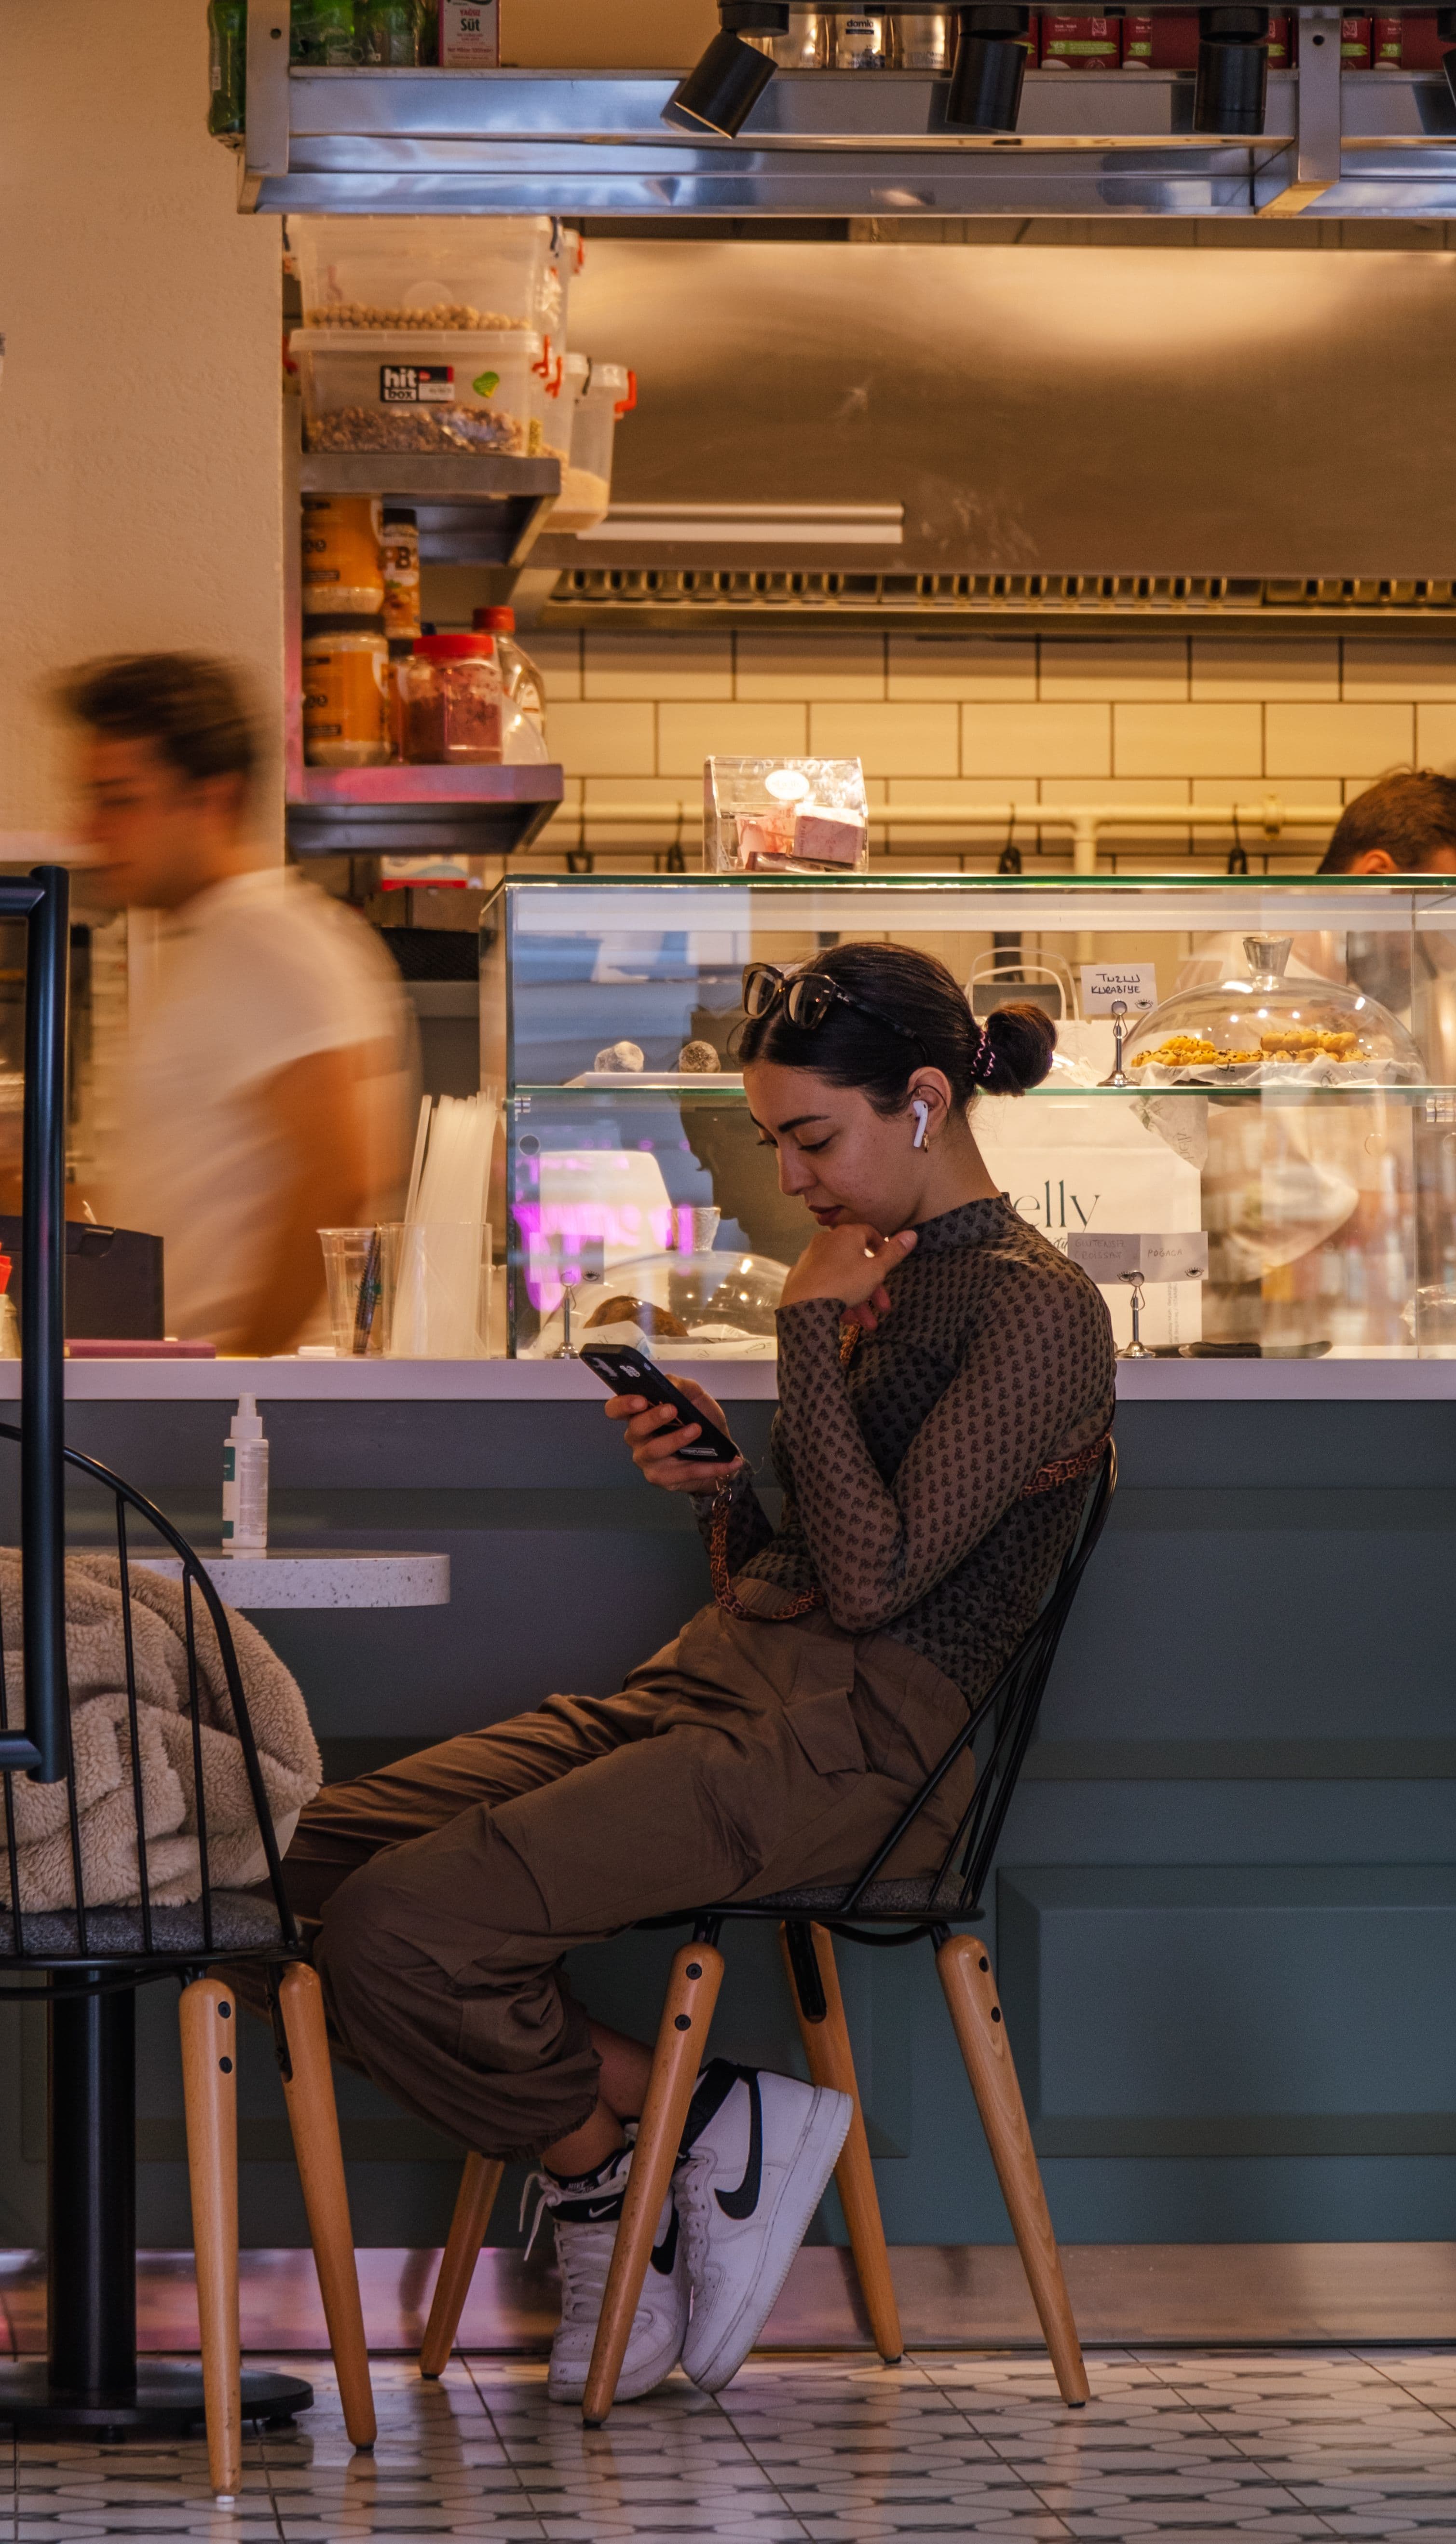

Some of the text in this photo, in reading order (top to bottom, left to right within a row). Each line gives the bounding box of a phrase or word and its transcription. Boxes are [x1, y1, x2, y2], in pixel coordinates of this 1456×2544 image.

[461, 18, 480, 31] Süt
[384, 368, 417, 387] hit
[388, 389, 413, 399] box
